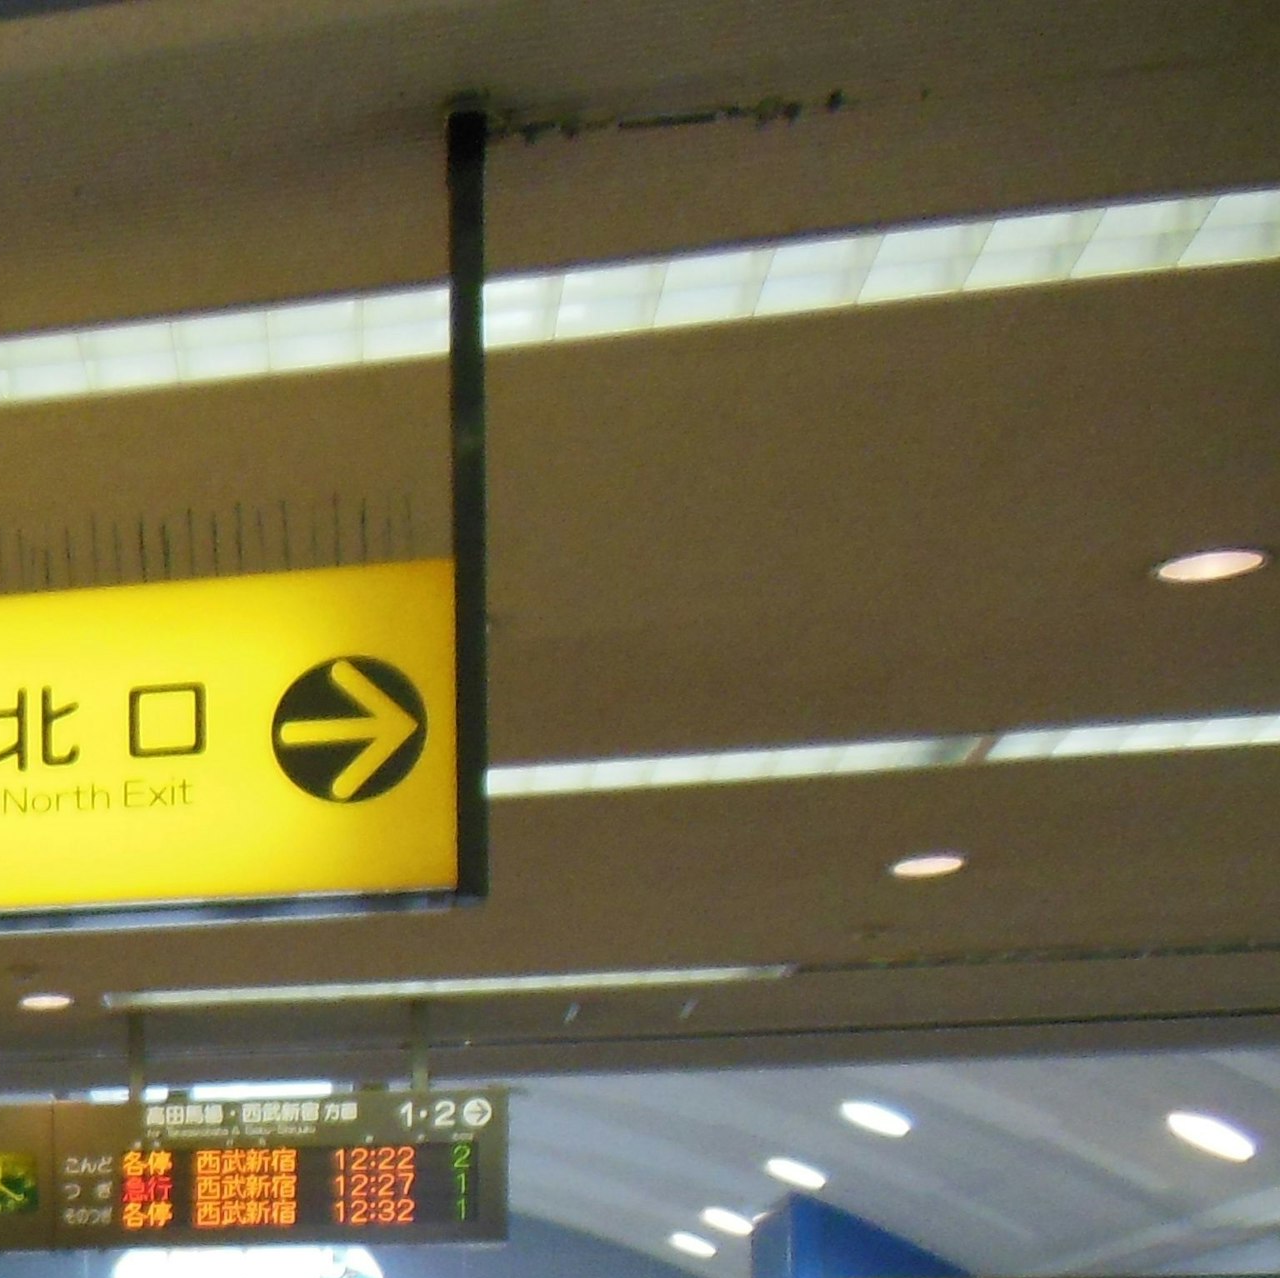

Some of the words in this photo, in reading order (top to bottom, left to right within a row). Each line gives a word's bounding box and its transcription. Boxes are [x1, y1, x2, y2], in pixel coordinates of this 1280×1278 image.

[1, 779, 114, 815] North
[122, 776, 193, 810] Exit
[65, 1156, 112, 1173] こんど
[123, 1150, 173, 1176] 各停
[196, 1148, 297, 1175] 西武新宿
[335, 1146, 415, 1173] 12:22
[453, 1145, 471, 1168] 2
[122, 1176, 173, 1202] 急行
[196, 1173, 297, 1200] 西武新宿
[335, 1172, 415, 1198] 12:27
[456, 1172, 466, 1194] 1
[122, 1201, 173, 1227] 各停
[196, 1199, 297, 1226] 西武新宿
[335, 1198, 415, 1224] 12:32
[456, 1198, 466, 1221] 1
